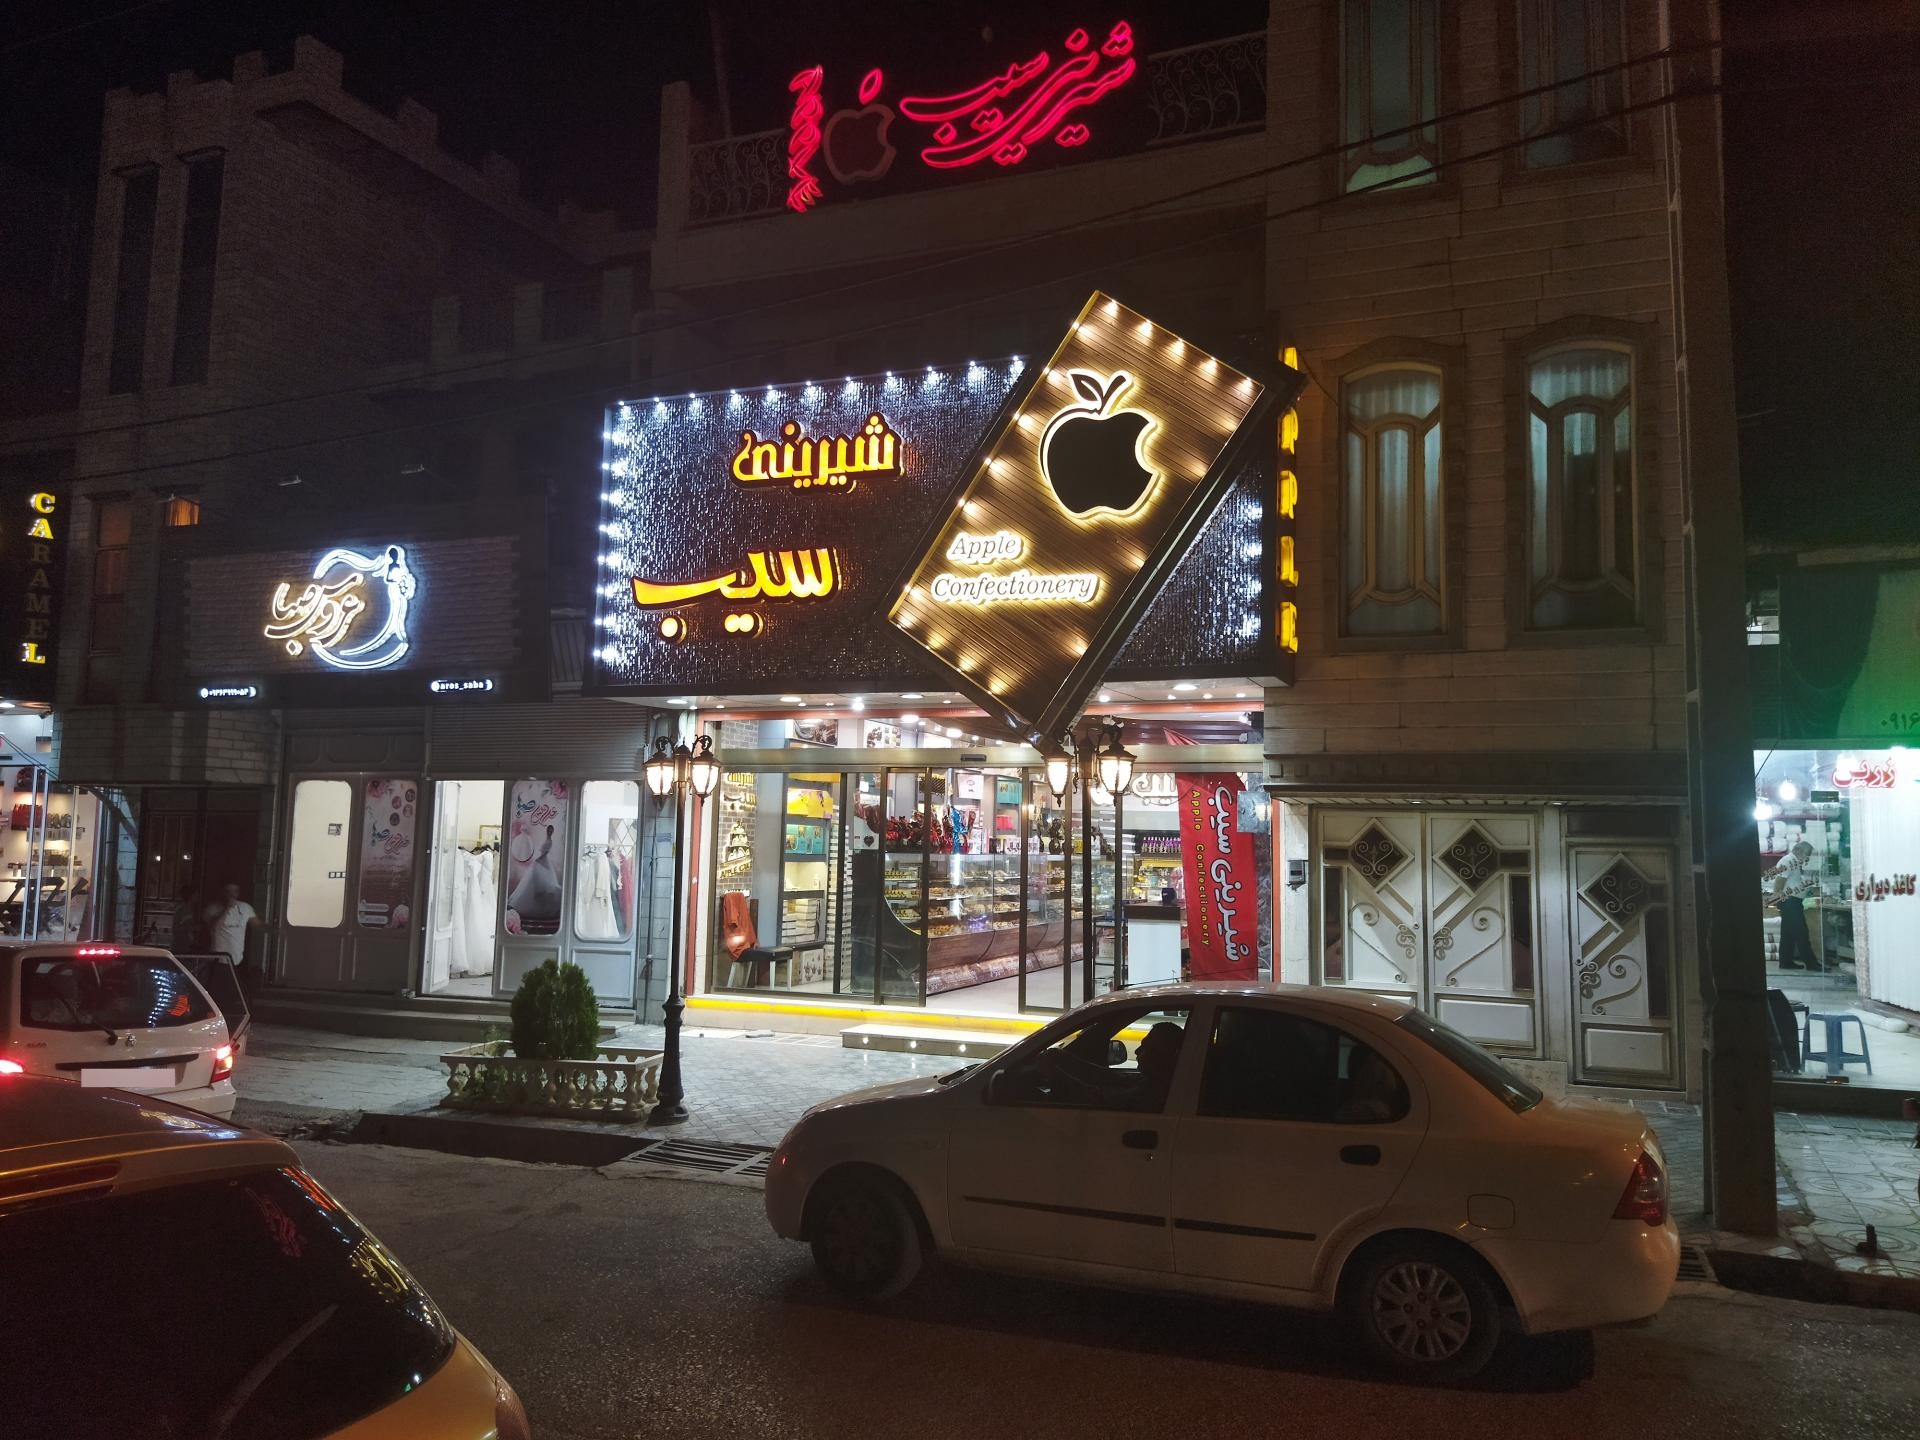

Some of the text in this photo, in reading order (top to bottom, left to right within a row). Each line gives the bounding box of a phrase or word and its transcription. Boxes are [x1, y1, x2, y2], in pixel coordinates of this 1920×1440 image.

[900, 20, 1136, 169] شیرینی سیب
[732, 413, 902, 490] شیرینی
[22, 492, 56, 664] CARAMEL
[633, 547, 842, 642] سیب
[933, 570, 1094, 601] Confectionery
[950, 534, 1018, 561] Apple
[1191, 789, 1209, 946] Apple Confectionery
[1207, 785, 1250, 962] شیرینی سیب
[1855, 872, 1917, 902] کاغذ دیواری
